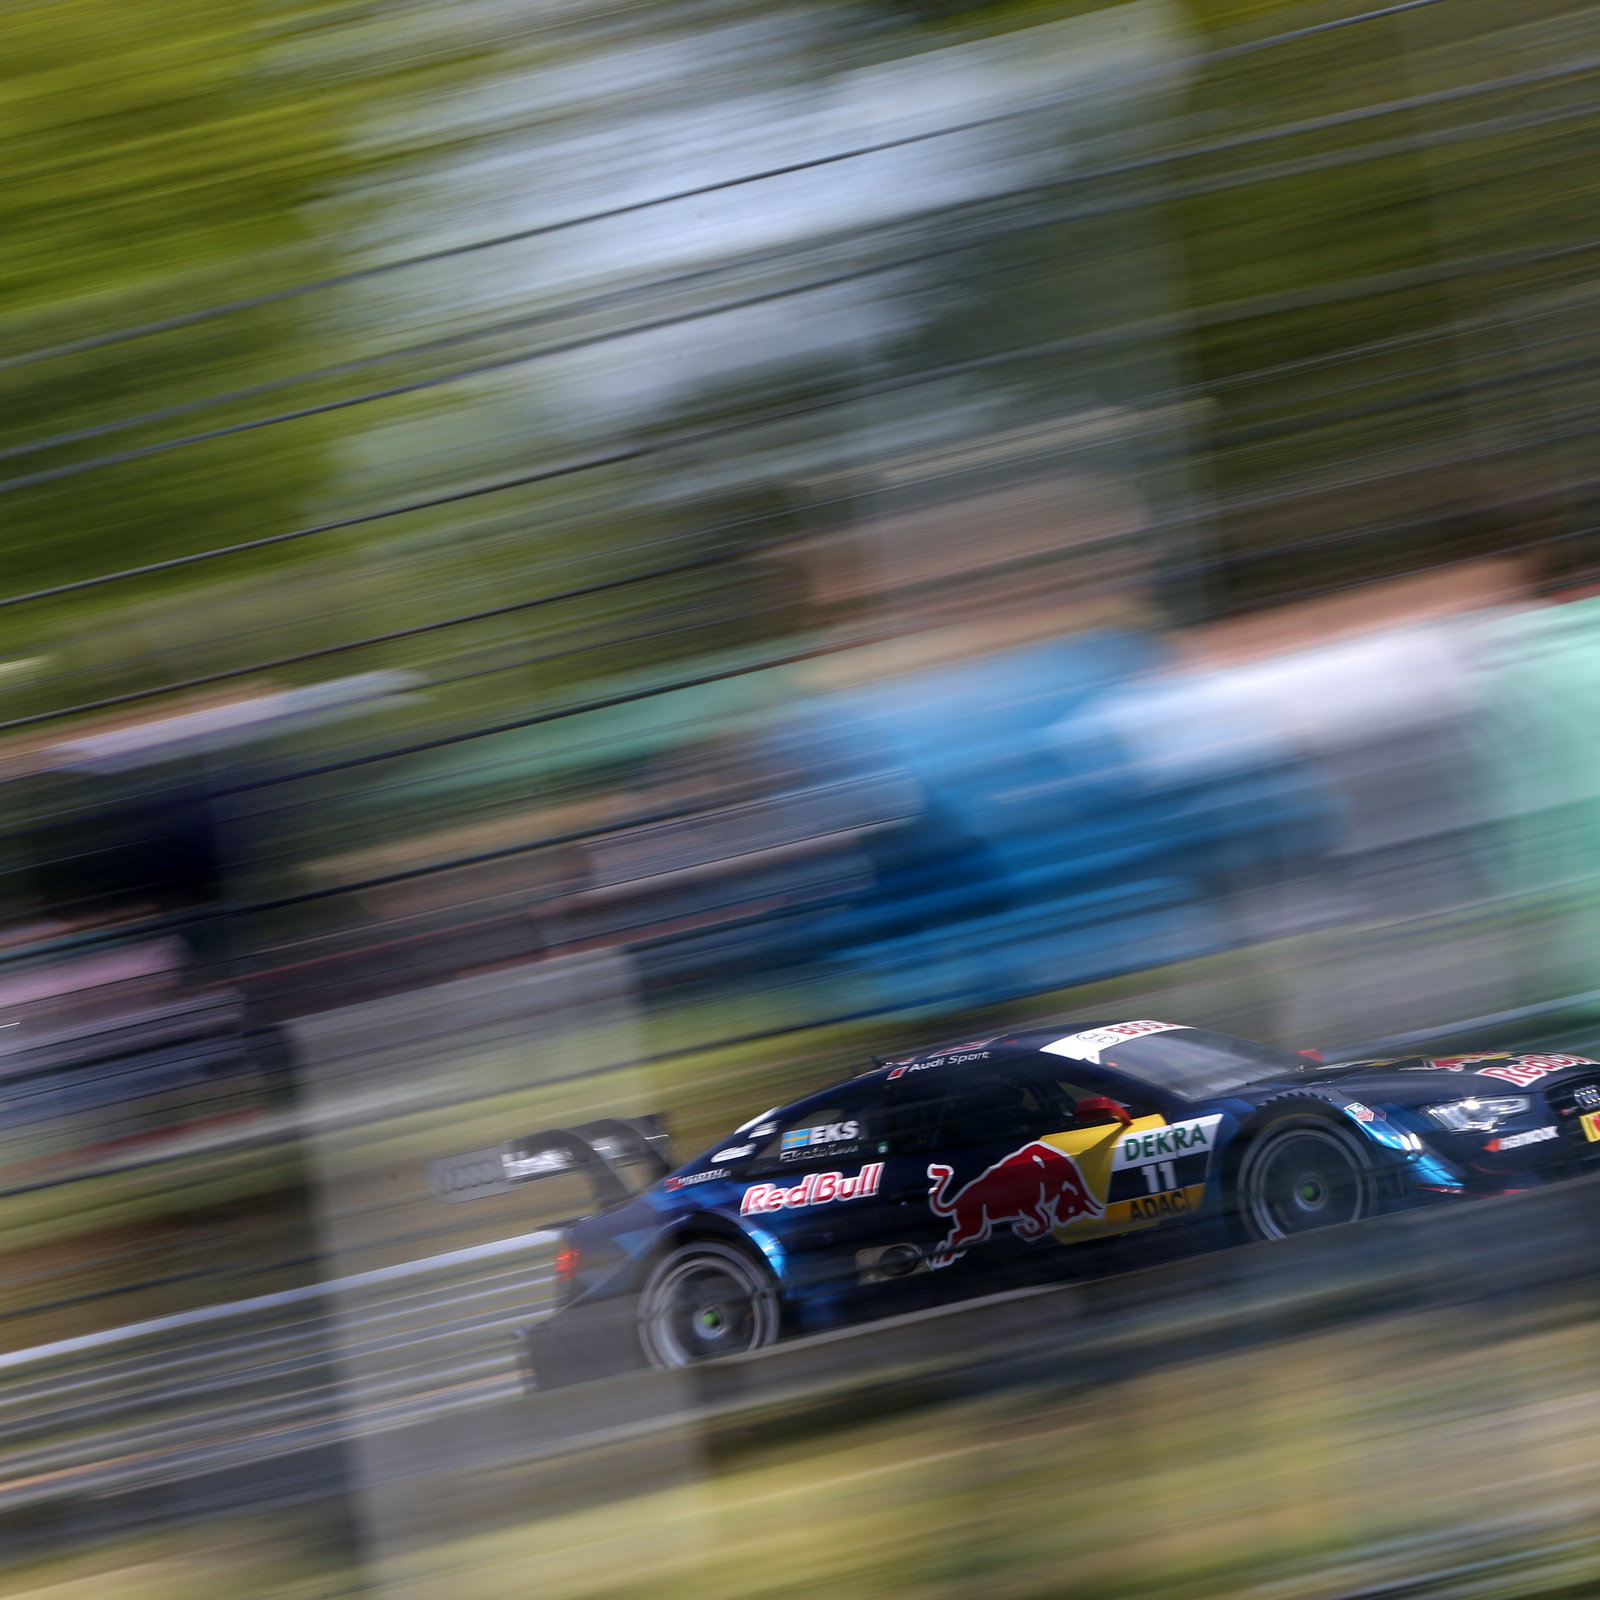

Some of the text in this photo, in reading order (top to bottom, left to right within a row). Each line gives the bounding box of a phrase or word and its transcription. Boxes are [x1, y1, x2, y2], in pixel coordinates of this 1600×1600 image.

[908, 1051, 990, 1072] Audi Sport
[809, 1120, 860, 1144] EKS
[1124, 1124, 1207, 1161] DEKRA
[1141, 1161, 1177, 1193] 11
